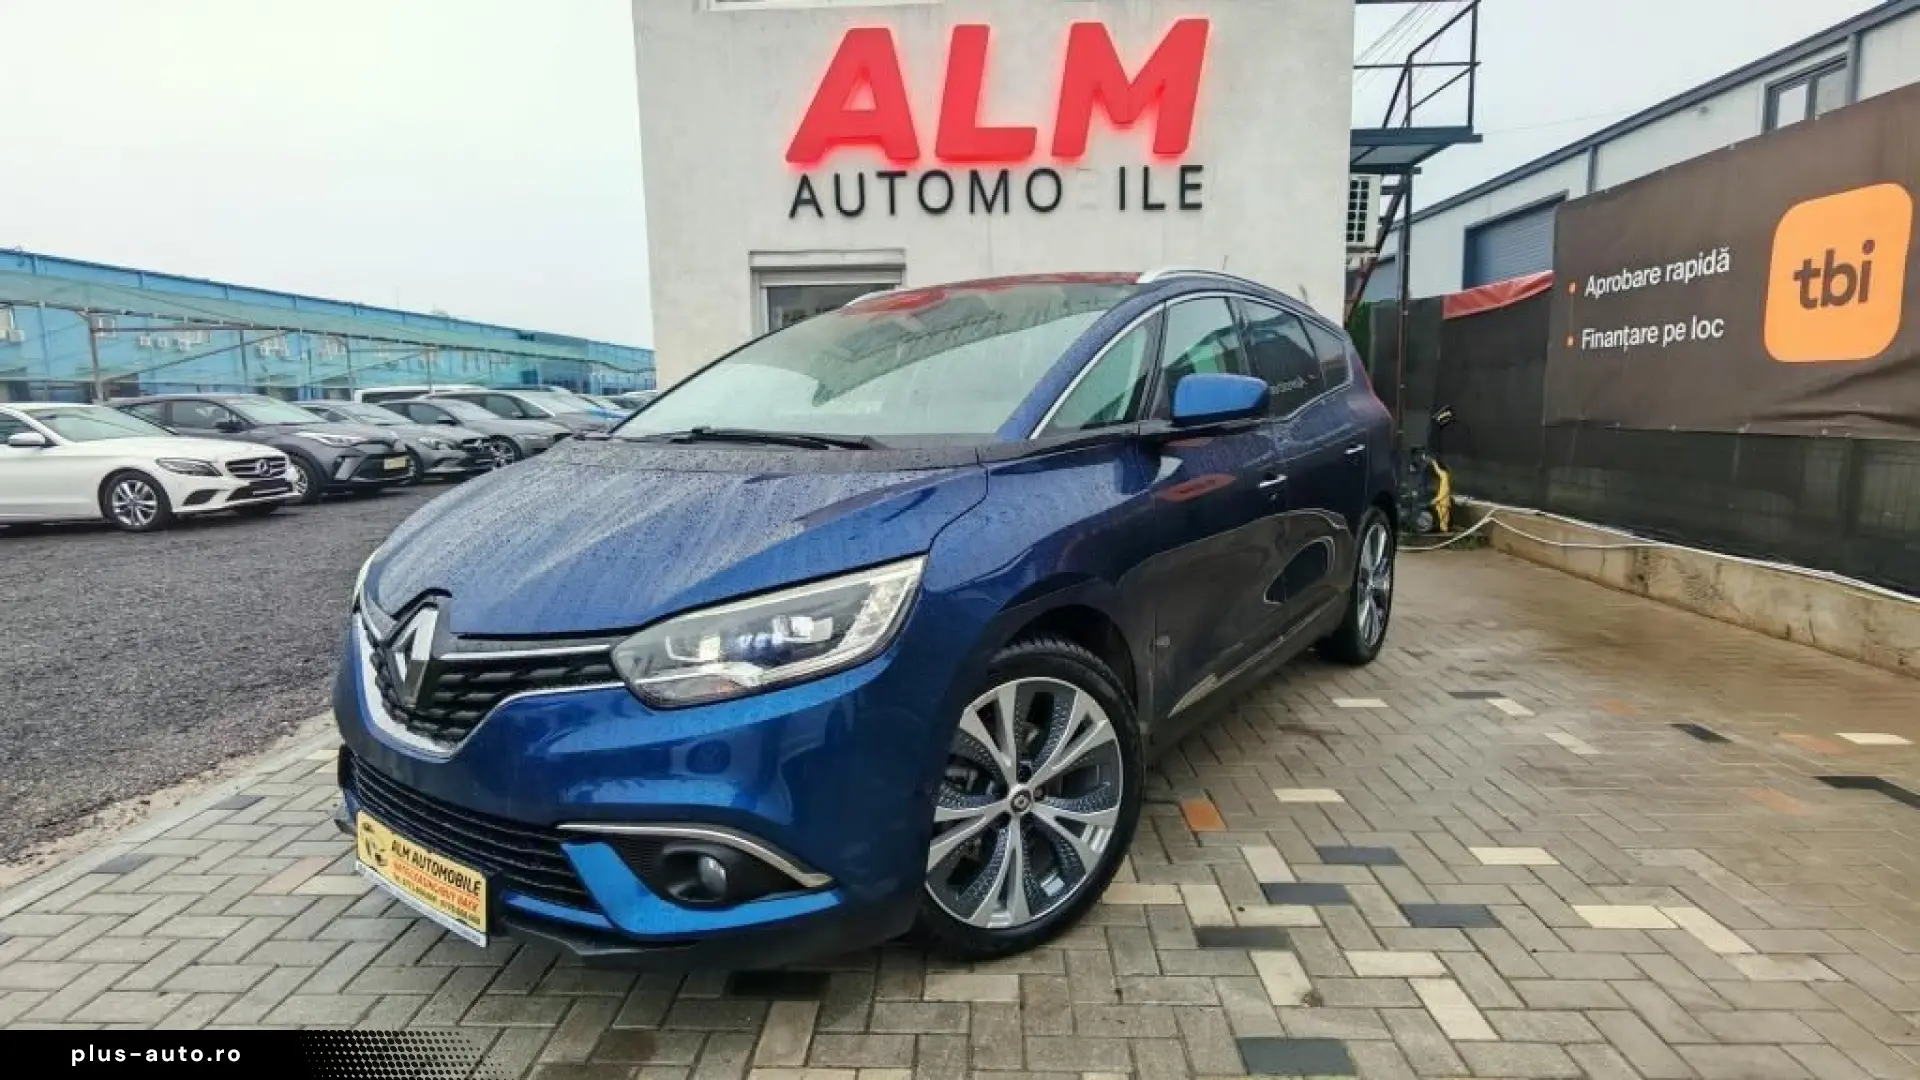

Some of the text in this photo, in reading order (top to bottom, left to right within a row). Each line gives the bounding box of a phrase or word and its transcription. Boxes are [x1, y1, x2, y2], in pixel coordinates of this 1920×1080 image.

[786, 18, 1209, 162] ALM
[789, 165, 1204, 218] AUTOMOILE
[1584, 247, 1731, 299] Aprobare rapidă
[1793, 239, 1876, 310] tbi
[1662, 321, 1687, 348] pe
[1690, 315, 1725, 339] loc
[391, 839, 410, 860] ALM
[412, 851, 483, 896] AUTOMOBILE
